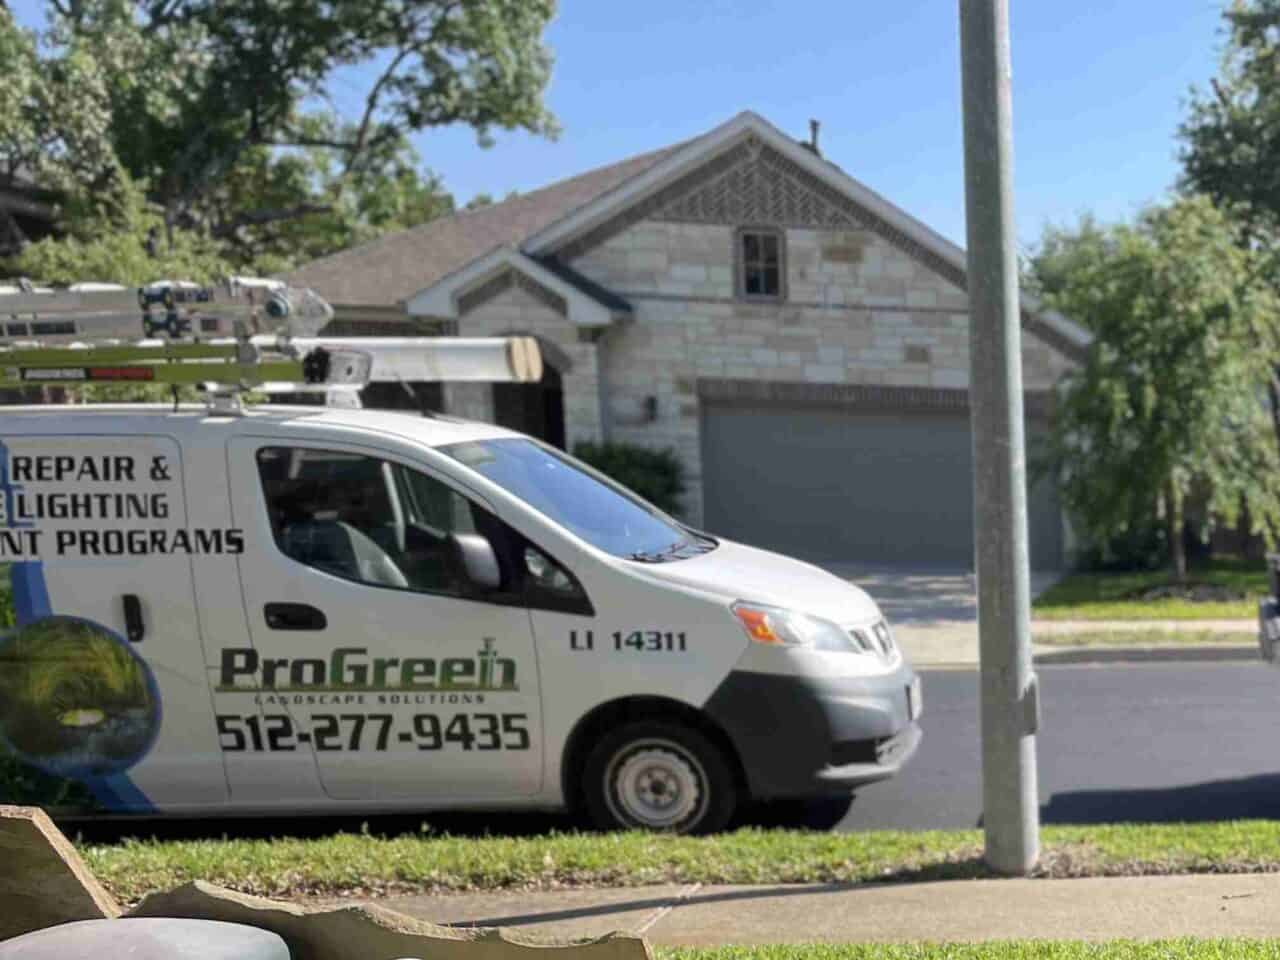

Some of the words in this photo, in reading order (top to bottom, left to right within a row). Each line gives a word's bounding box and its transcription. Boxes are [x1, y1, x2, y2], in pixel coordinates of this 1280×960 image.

[11, 455, 136, 482] REPAIR
[149, 455, 172, 481] &
[17, 493, 169, 519] LIGHTING
[56, 528, 245, 555] PROGRAMS
[569, 631, 595, 652] LI
[612, 630, 687, 652] 14311
[254, 694, 366, 705] LANDSCAPE
[377, 693, 486, 705] SOLUTIONS
[216, 712, 531, 752] 512-277-9435
